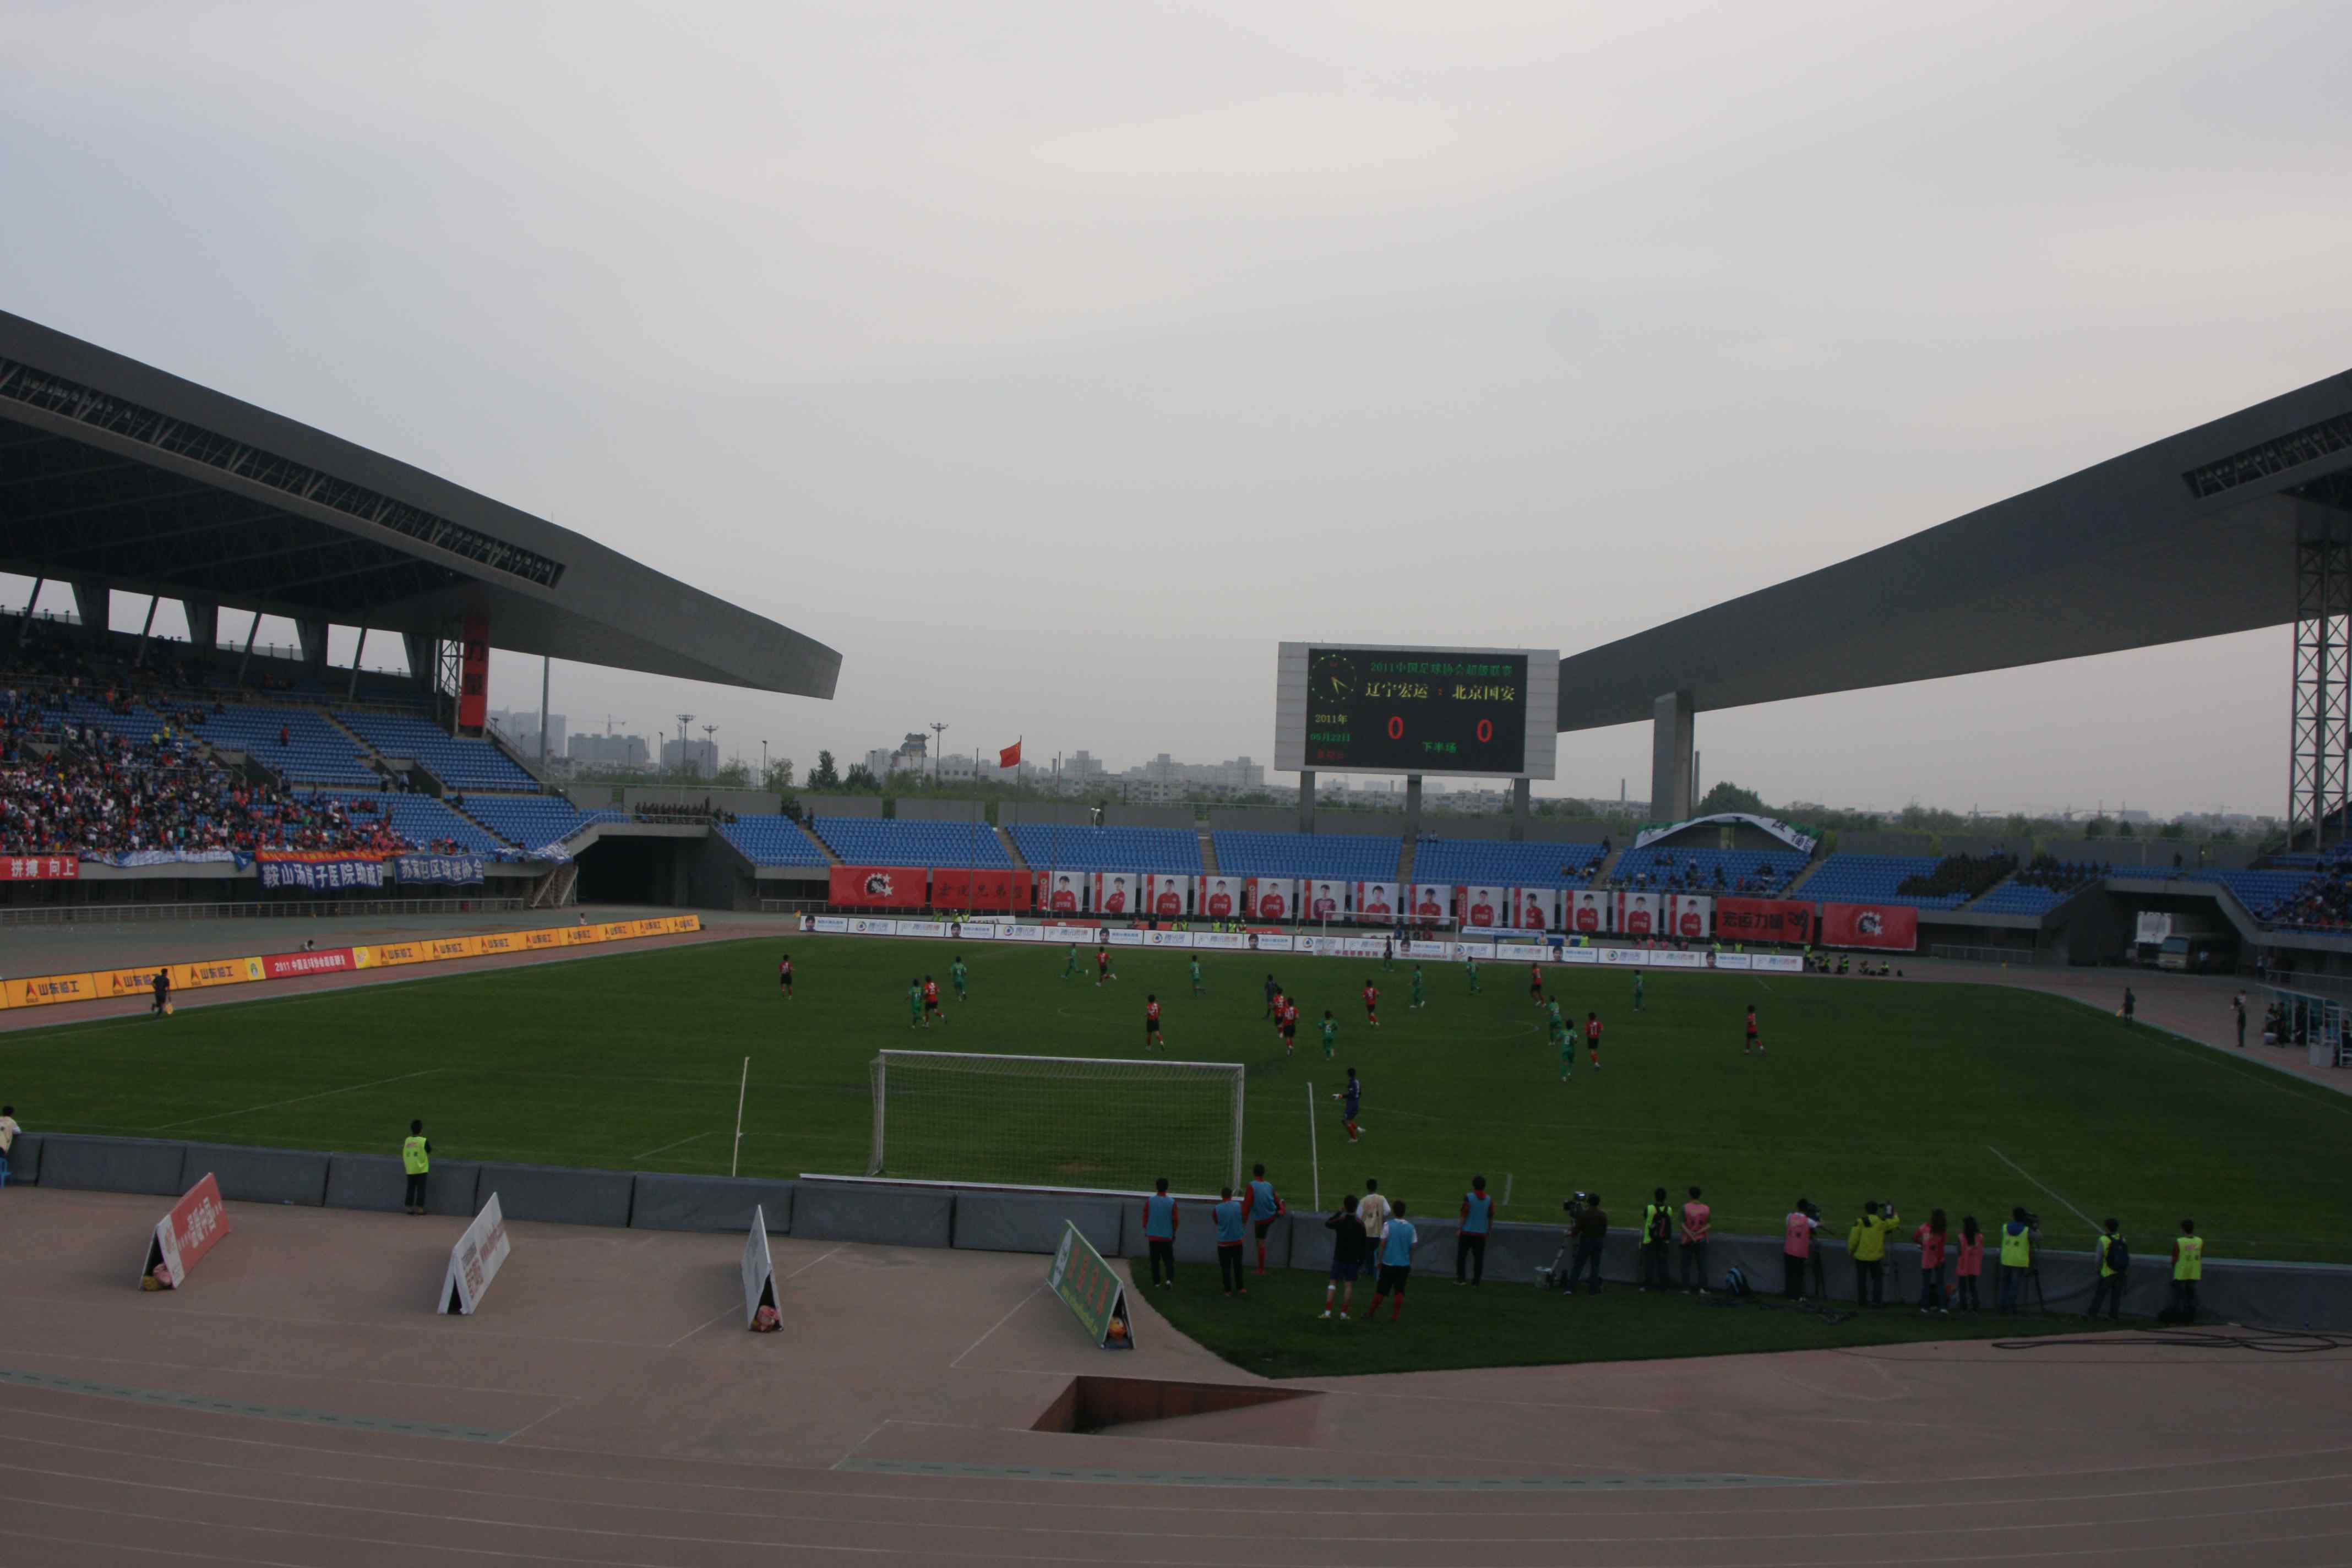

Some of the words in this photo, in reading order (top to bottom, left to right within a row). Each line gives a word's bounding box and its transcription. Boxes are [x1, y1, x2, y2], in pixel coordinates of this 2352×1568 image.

[1365, 682, 1428, 699] 辽宁宏运
[1452, 684, 1515, 701] 北京国安
[1315, 714, 1348, 725] 2011年
[1388, 716, 1404, 739] 0
[1477, 719, 1493, 743] 0
[1422, 741, 1458, 754] 下半场
[48, 858, 75, 876] 向上
[399, 858, 484, 881] 苏家屯区球迷协会
[200, 966, 235, 979] 山东临工
[274, 961, 290, 972] 2011
[39, 981, 80, 996] 山东临工
